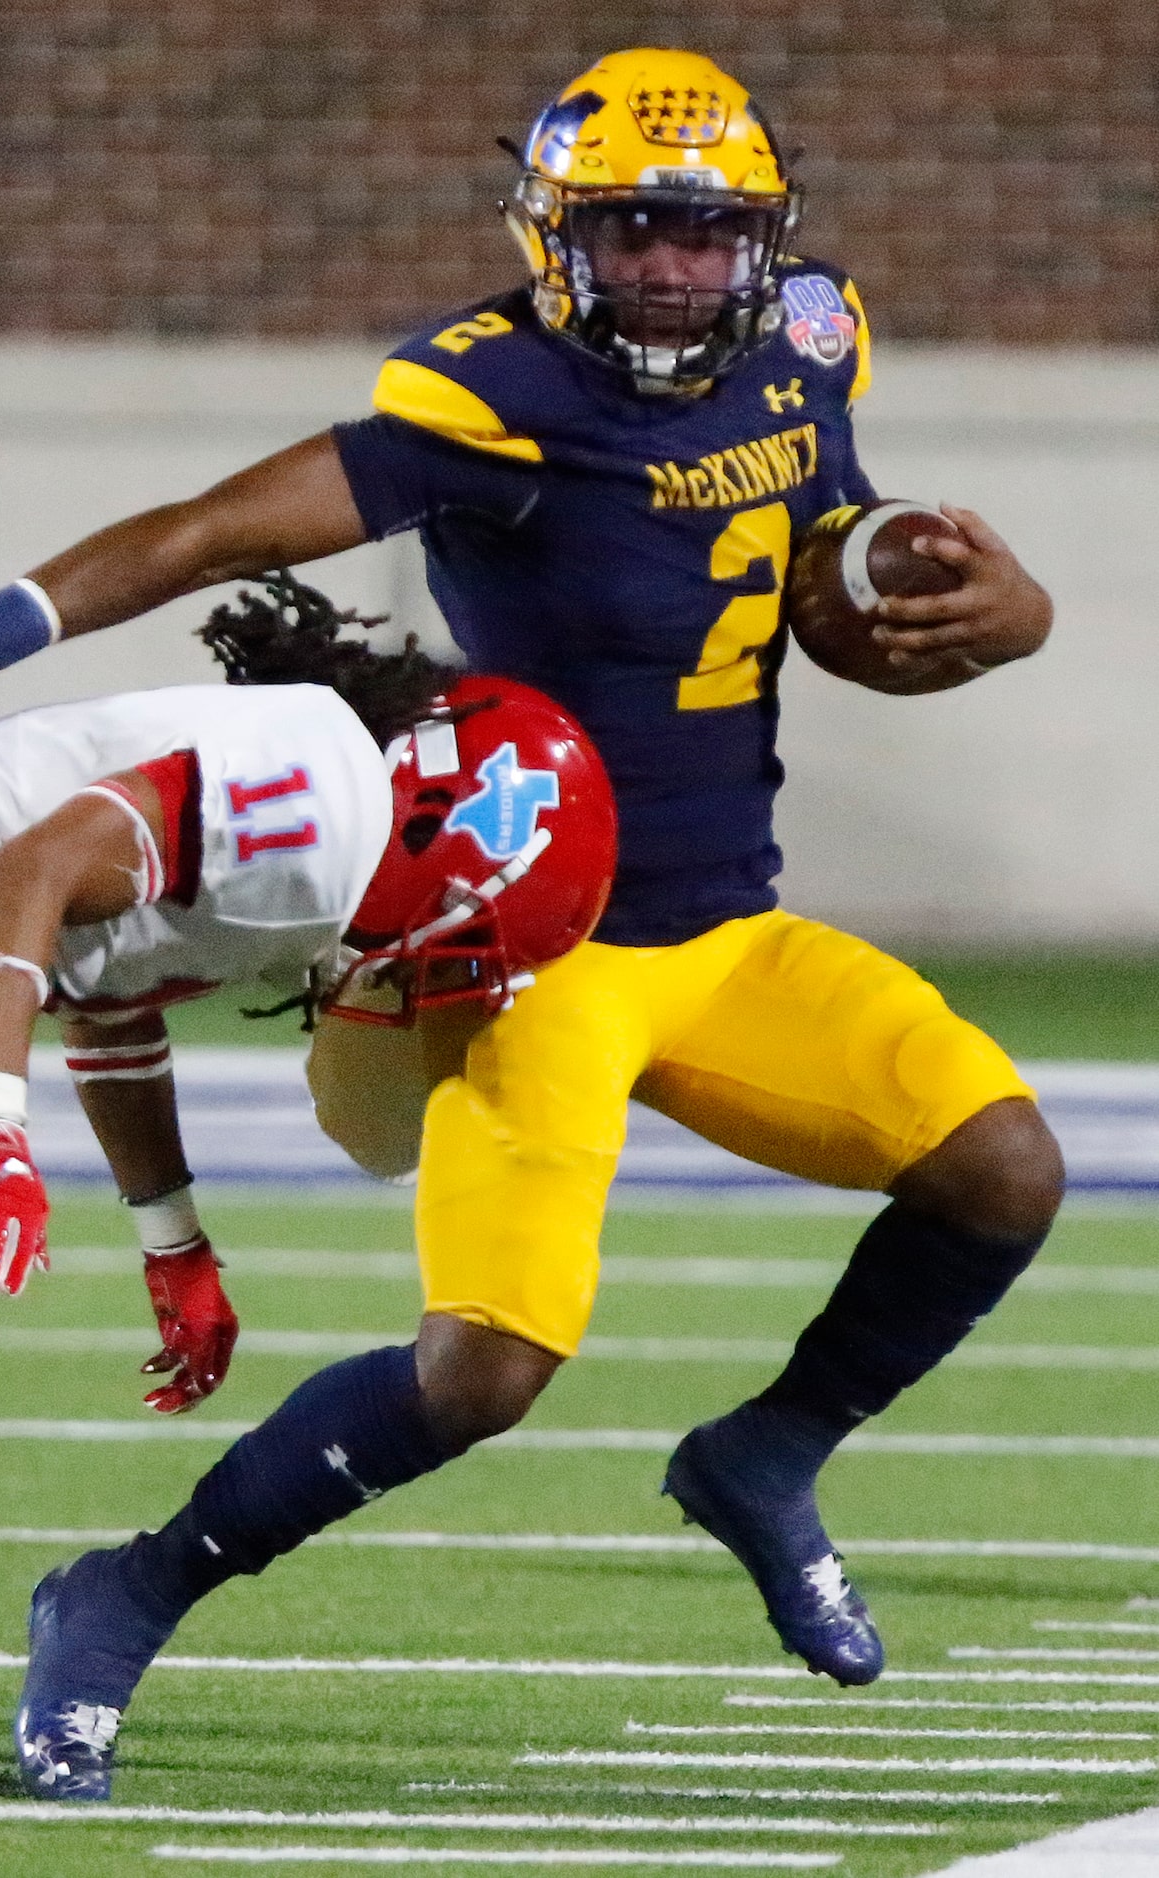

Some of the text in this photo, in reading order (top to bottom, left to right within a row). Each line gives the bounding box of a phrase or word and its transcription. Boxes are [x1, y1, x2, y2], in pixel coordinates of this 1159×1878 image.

[430, 311, 513, 353] 2
[781, 275, 845, 321] 100
[676, 502, 791, 711] 2
[222, 763, 321, 867] 11
